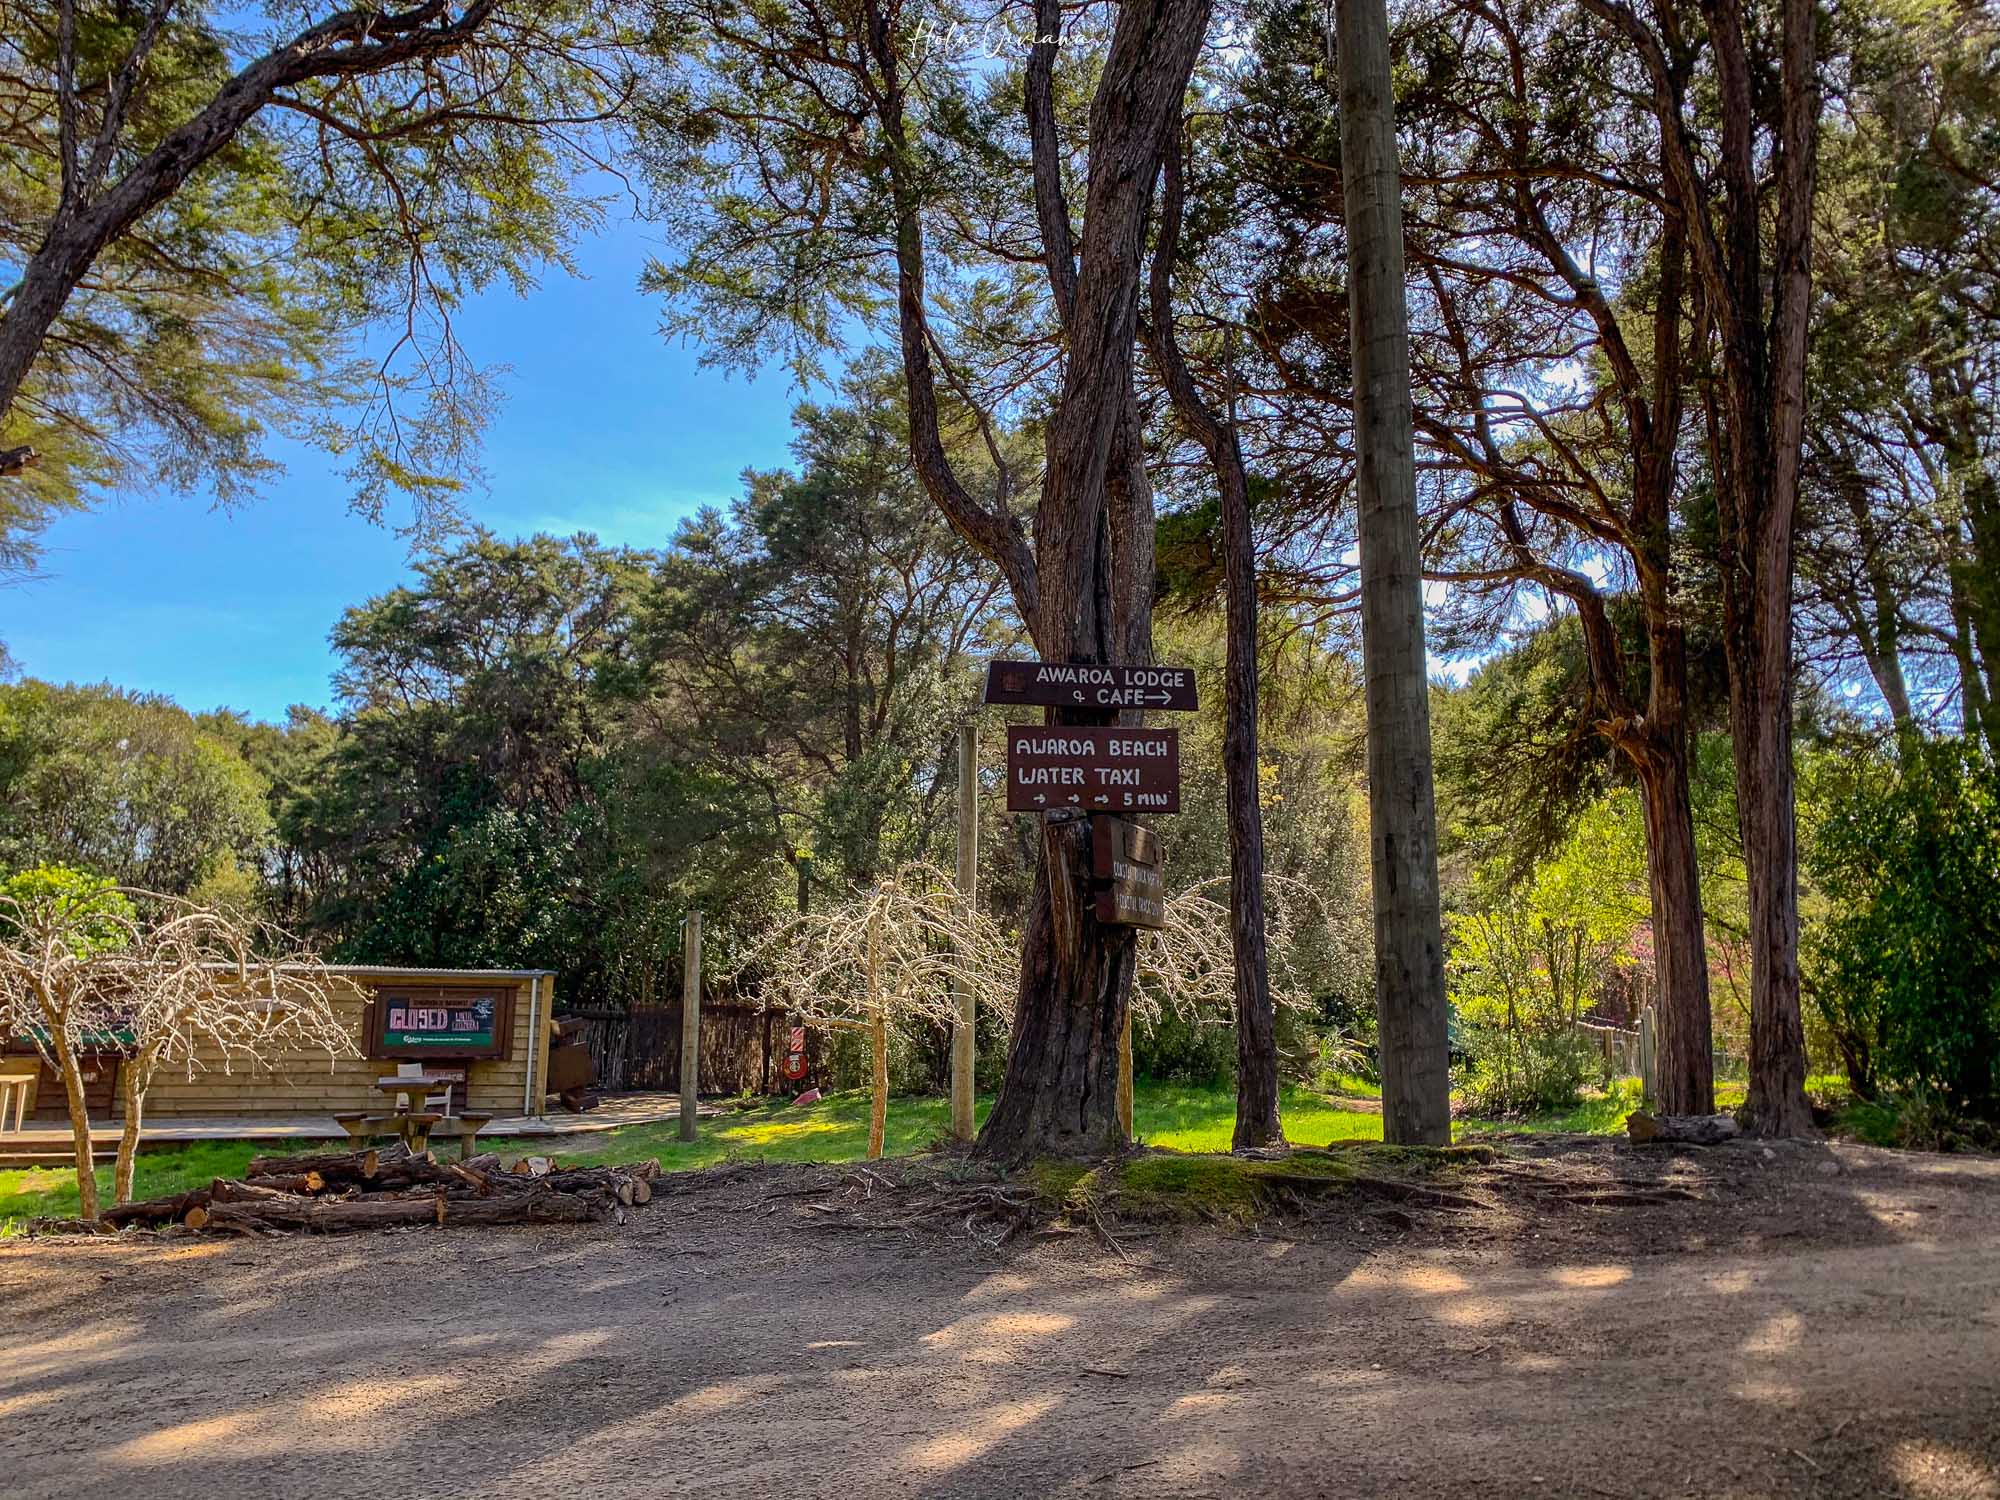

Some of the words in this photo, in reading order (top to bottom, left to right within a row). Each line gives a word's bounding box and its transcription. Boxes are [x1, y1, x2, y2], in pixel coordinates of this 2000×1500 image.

[1036, 667, 1114, 685] AWAROA
[1125, 668, 1184, 688] LODGE
[1097, 689, 1145, 705] CAFE
[1016, 739, 1095, 756] AWAROA
[1109, 740, 1167, 757] BEACH
[1018, 767, 1085, 785] WATER
[1094, 768, 1140, 785] TAXI
[1123, 792, 1133, 805] 5
[1137, 793, 1168, 806] MIN
[390, 1008, 448, 1030] CLOSED
